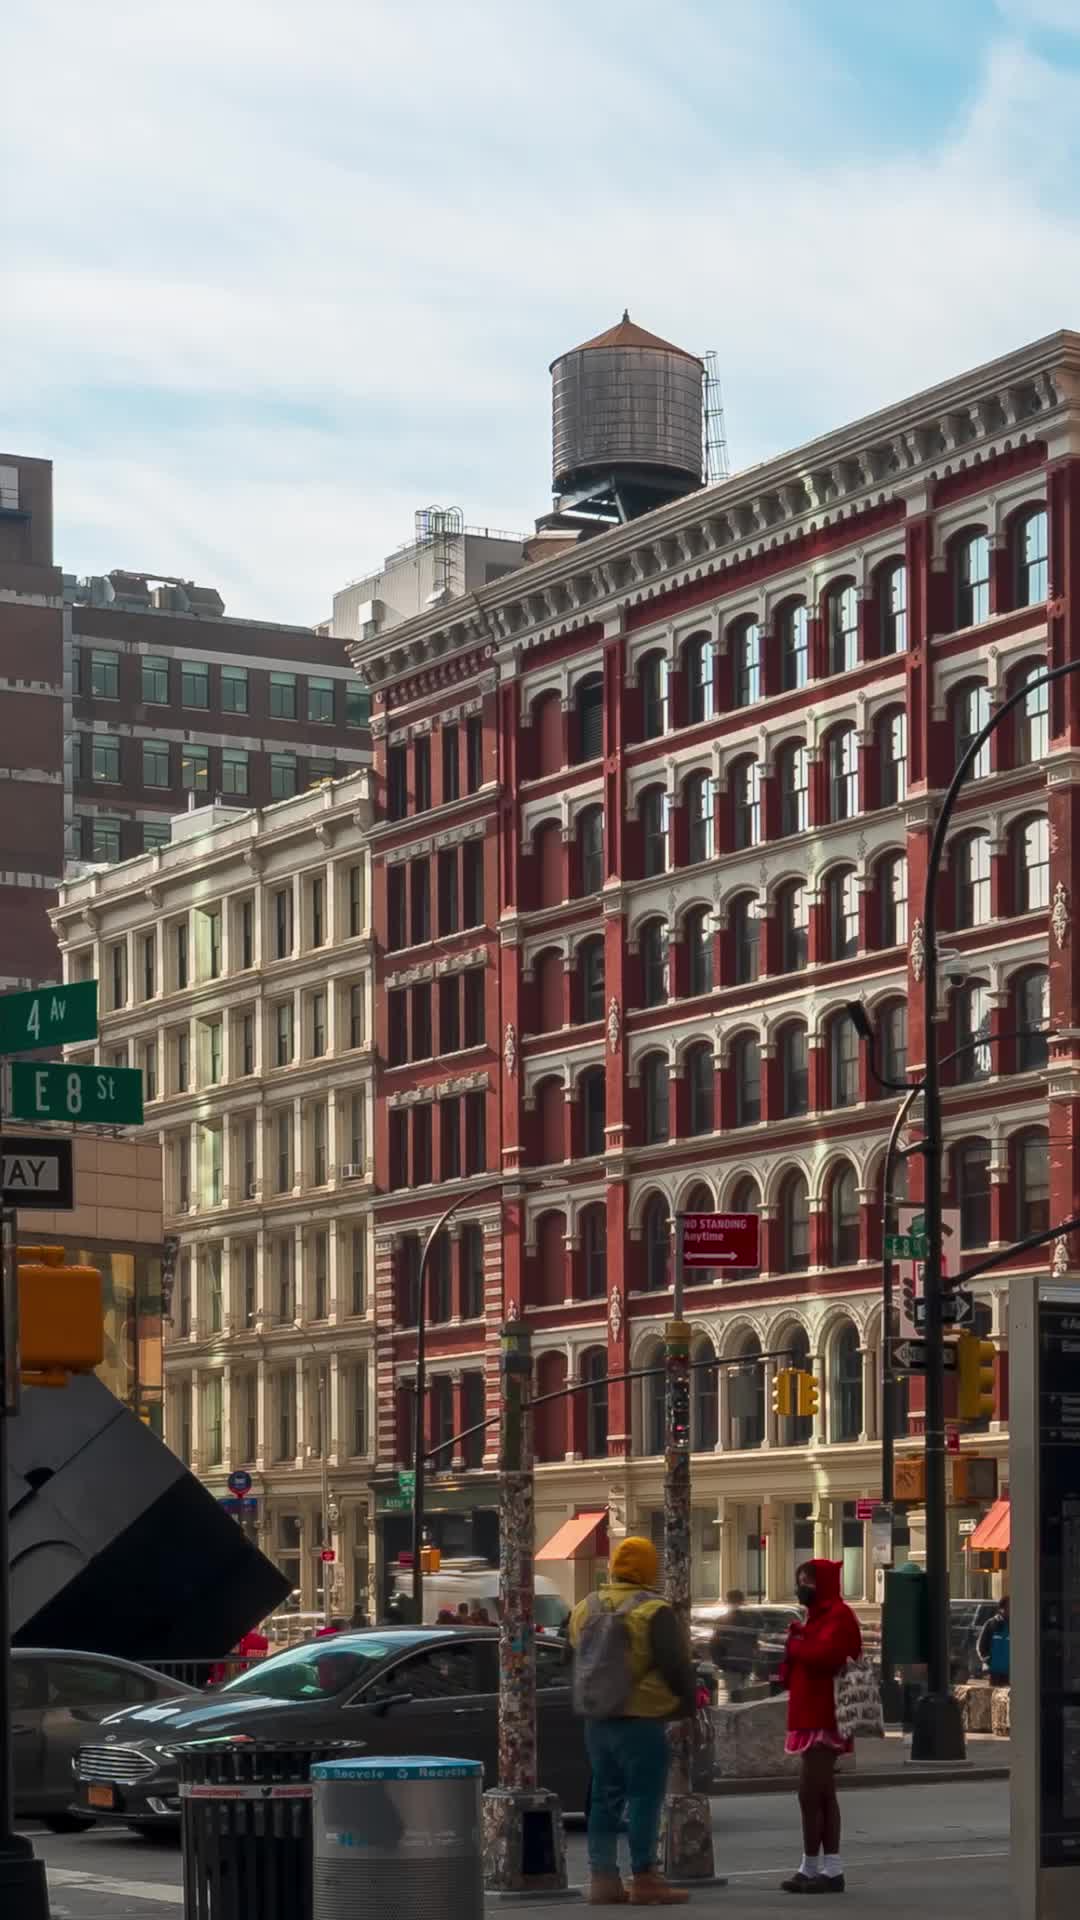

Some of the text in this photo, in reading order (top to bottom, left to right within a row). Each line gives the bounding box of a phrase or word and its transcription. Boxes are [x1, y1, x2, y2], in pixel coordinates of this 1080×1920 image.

[27, 996, 67, 1040] 4 Av
[35, 1071, 116, 1113] E 8 St
[684, 1219, 747, 1229] NO STANDING
[684, 1231, 724, 1243] Anytime
[419, 1767, 467, 1776] Recycle
